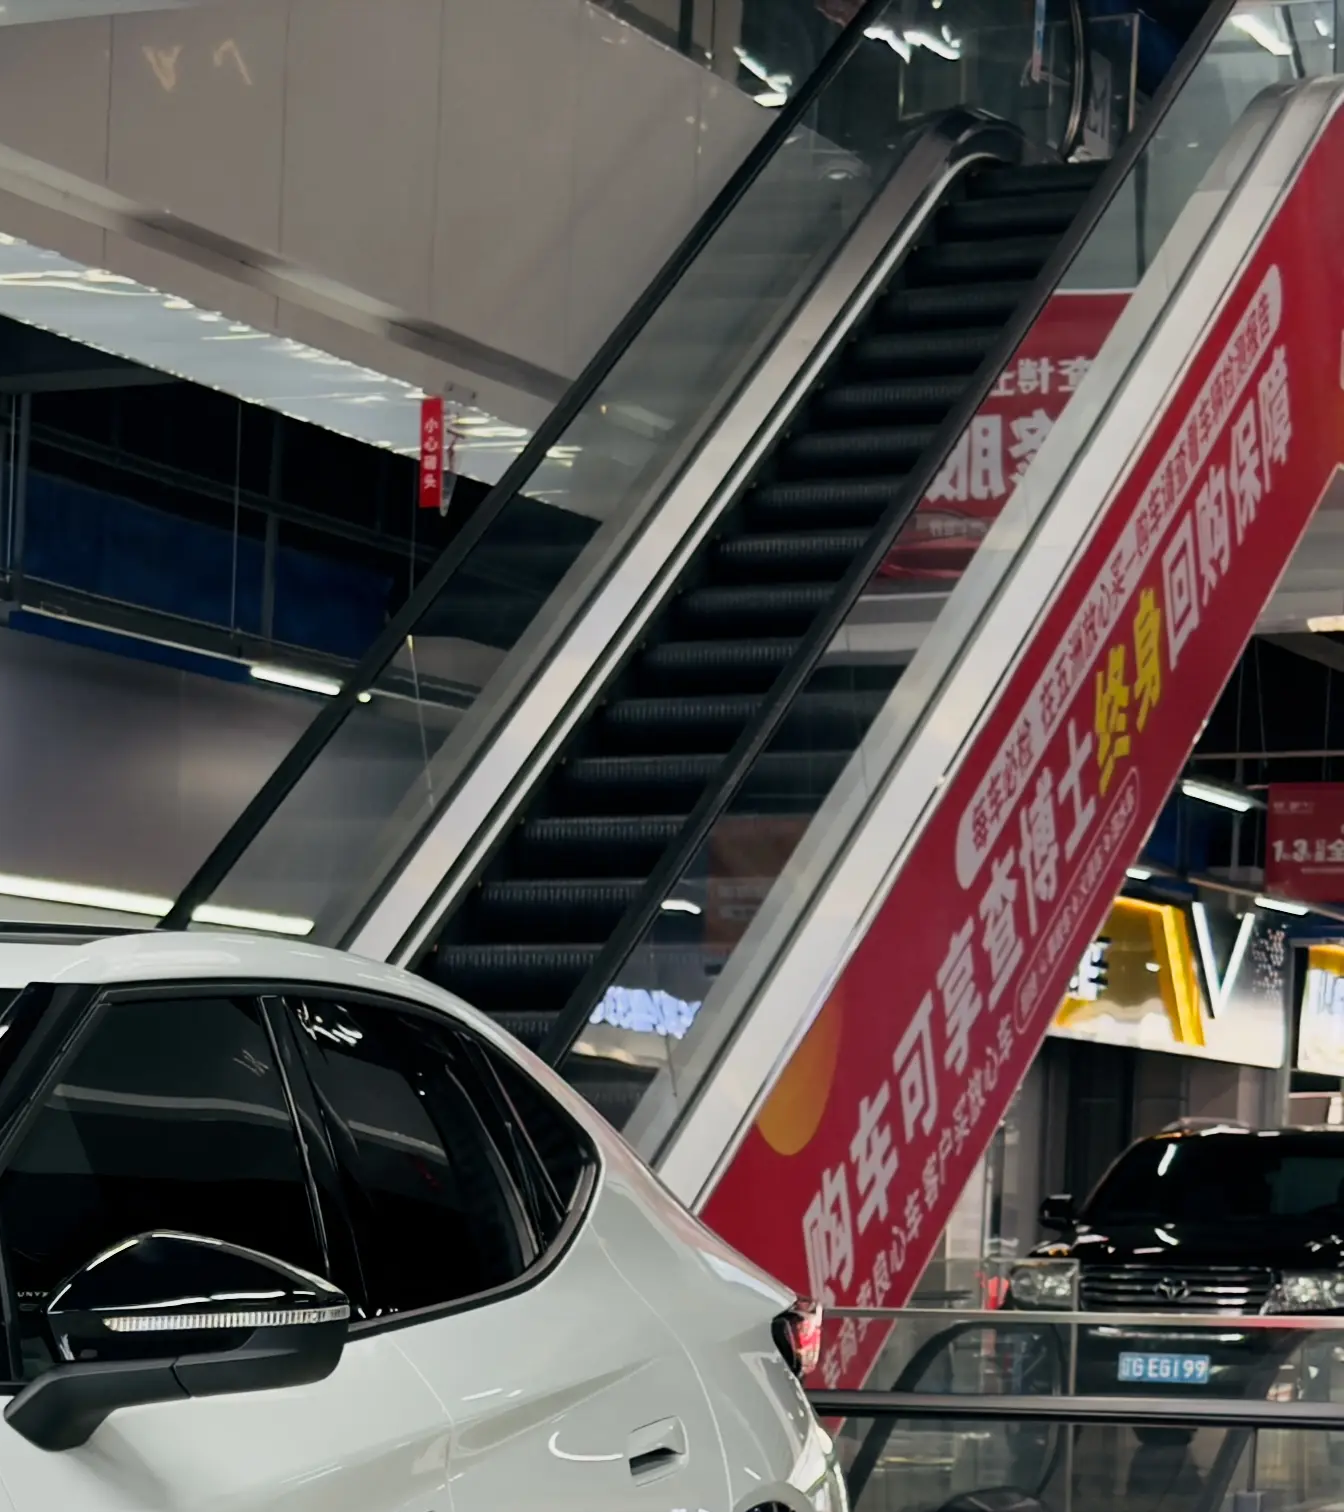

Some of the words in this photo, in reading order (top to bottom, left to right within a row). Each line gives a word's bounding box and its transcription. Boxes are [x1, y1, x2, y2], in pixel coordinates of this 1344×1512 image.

[802, 345, 1293, 1308] 购车可享查博士终身回购保障
